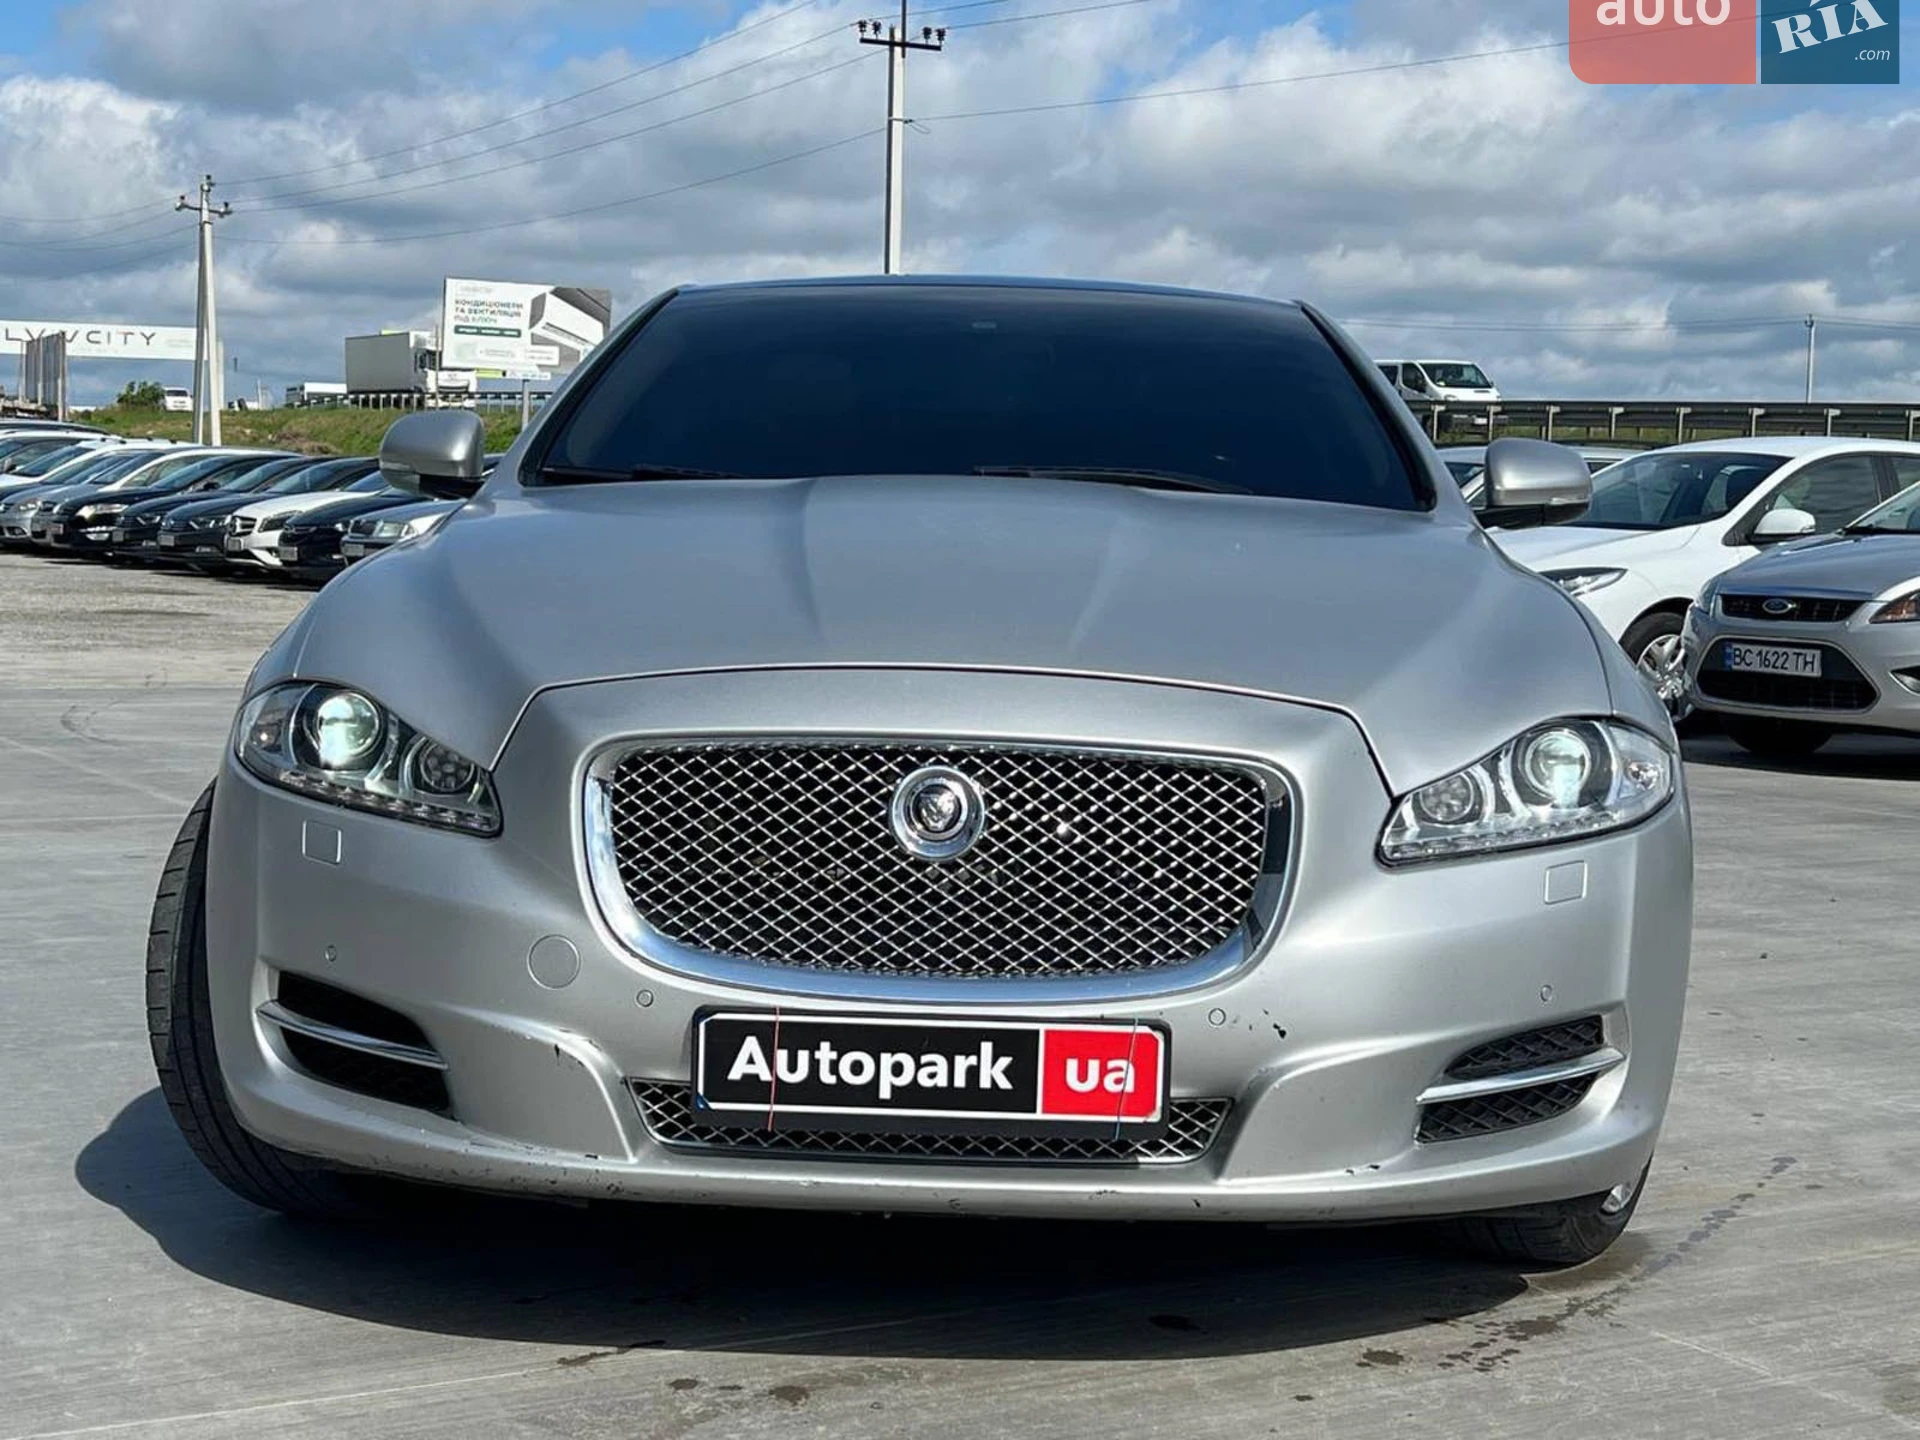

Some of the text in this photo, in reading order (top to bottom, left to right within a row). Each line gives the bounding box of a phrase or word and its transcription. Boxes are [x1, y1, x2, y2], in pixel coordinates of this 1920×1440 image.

[1733, 648, 1816, 672] BC 1622 TH
[727, 1035, 1135, 1100] Autopark ua
